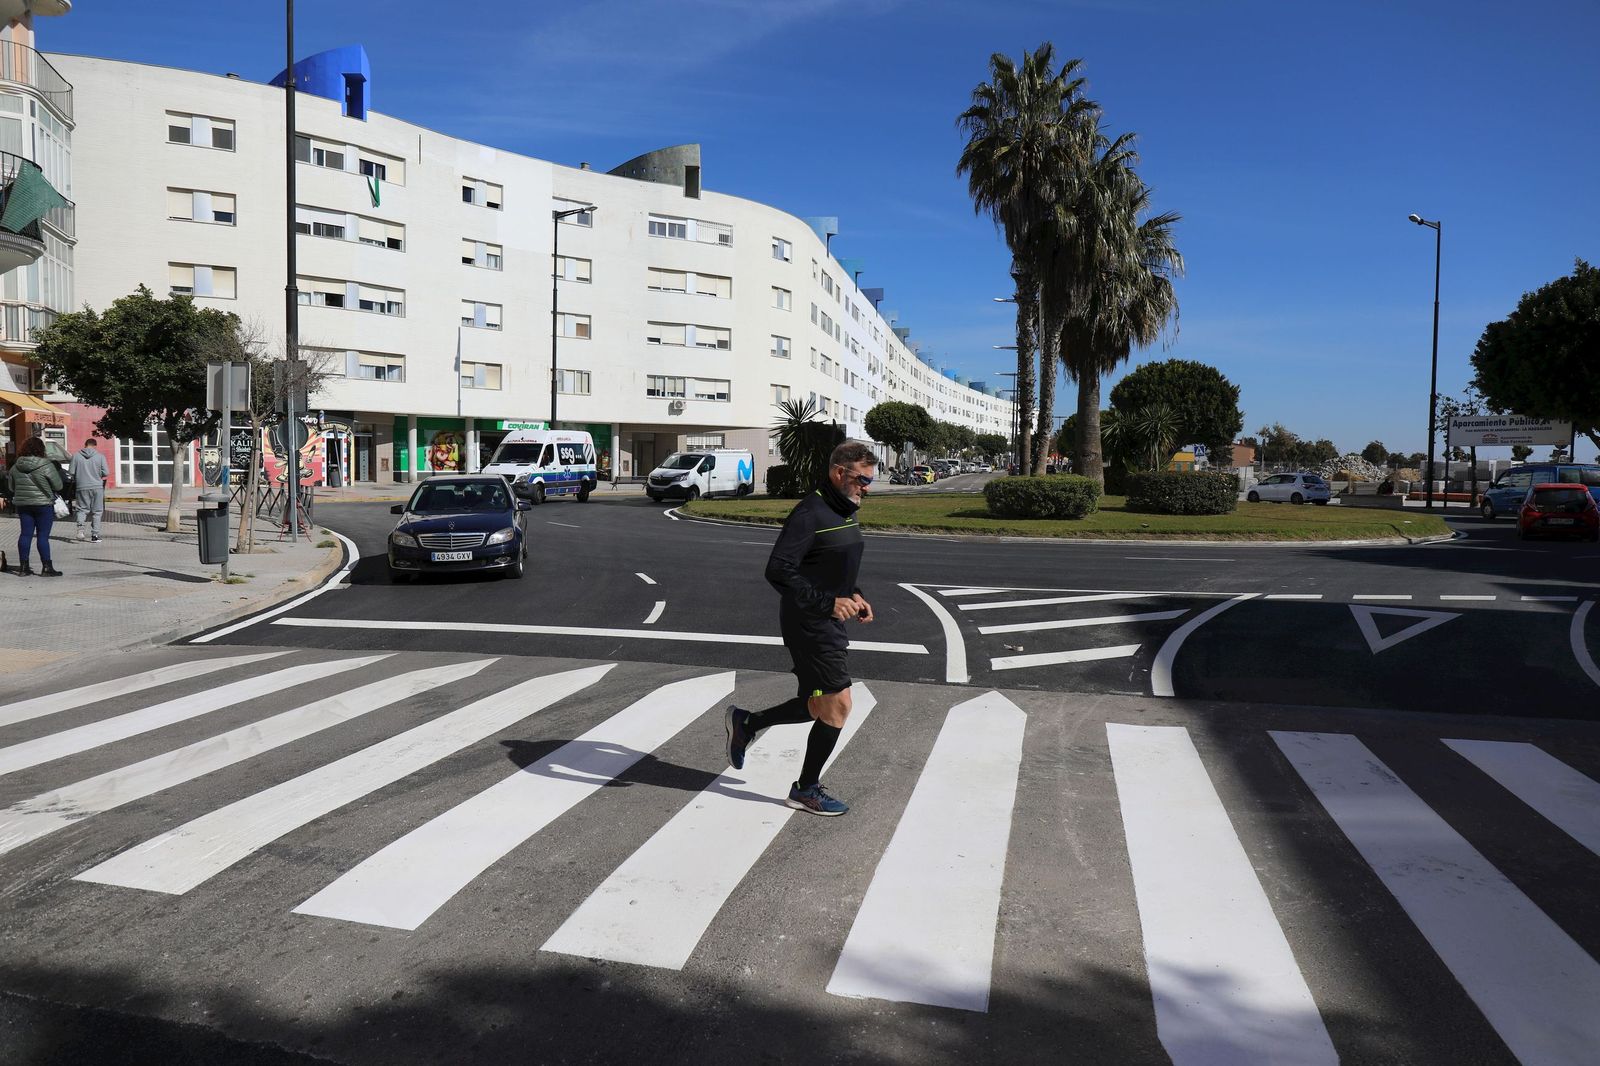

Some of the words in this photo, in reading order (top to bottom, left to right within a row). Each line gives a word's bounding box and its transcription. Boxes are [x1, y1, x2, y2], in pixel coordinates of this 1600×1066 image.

[1452, 418, 1507, 429] Aparcamiento
[1509, 416, 1539, 425] Público
[436, 553, 455, 561] 4934
[456, 552, 471, 560] GXV
